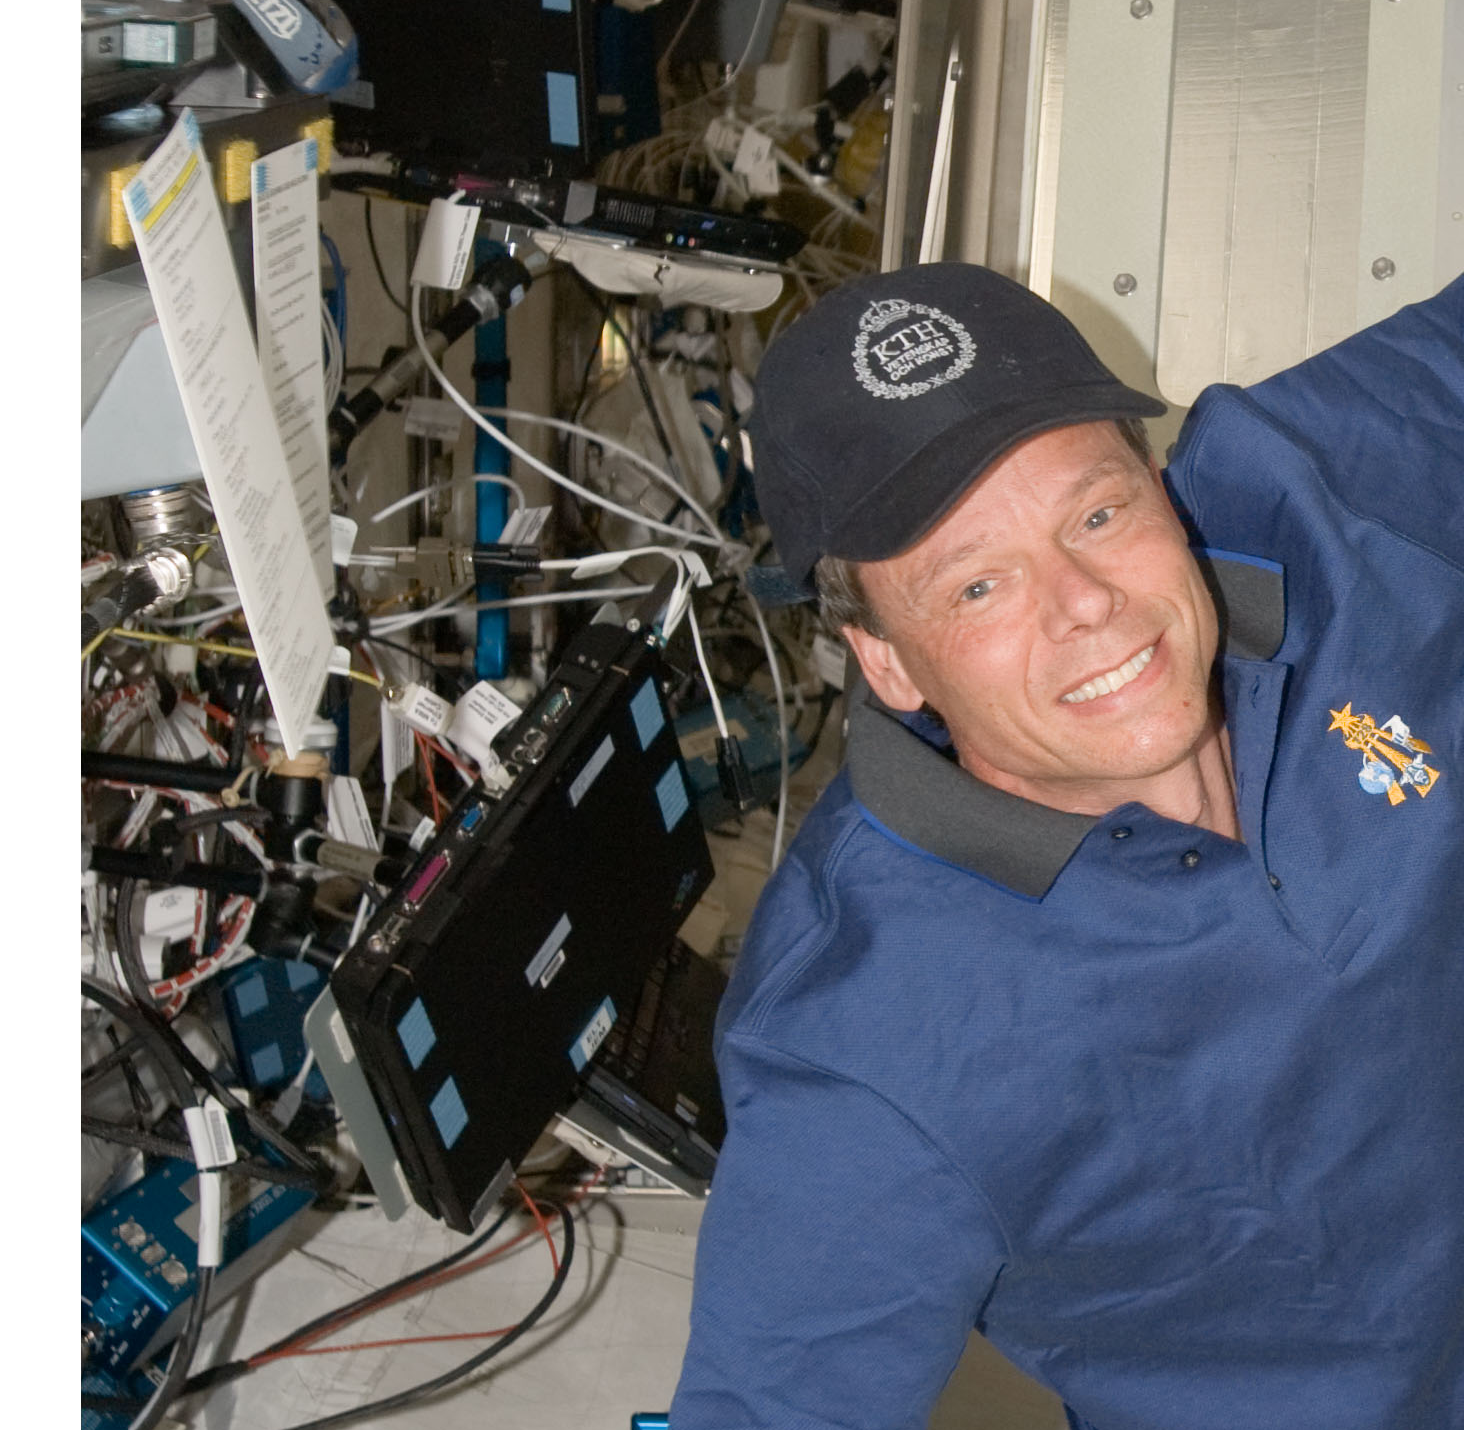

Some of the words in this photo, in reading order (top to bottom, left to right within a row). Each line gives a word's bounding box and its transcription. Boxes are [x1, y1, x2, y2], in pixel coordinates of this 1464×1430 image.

[870, 319, 945, 365] KTH
[883, 337, 951, 373] VETENSKAP
[890, 360, 915, 382] OCH
[914, 344, 955, 366] KONST
